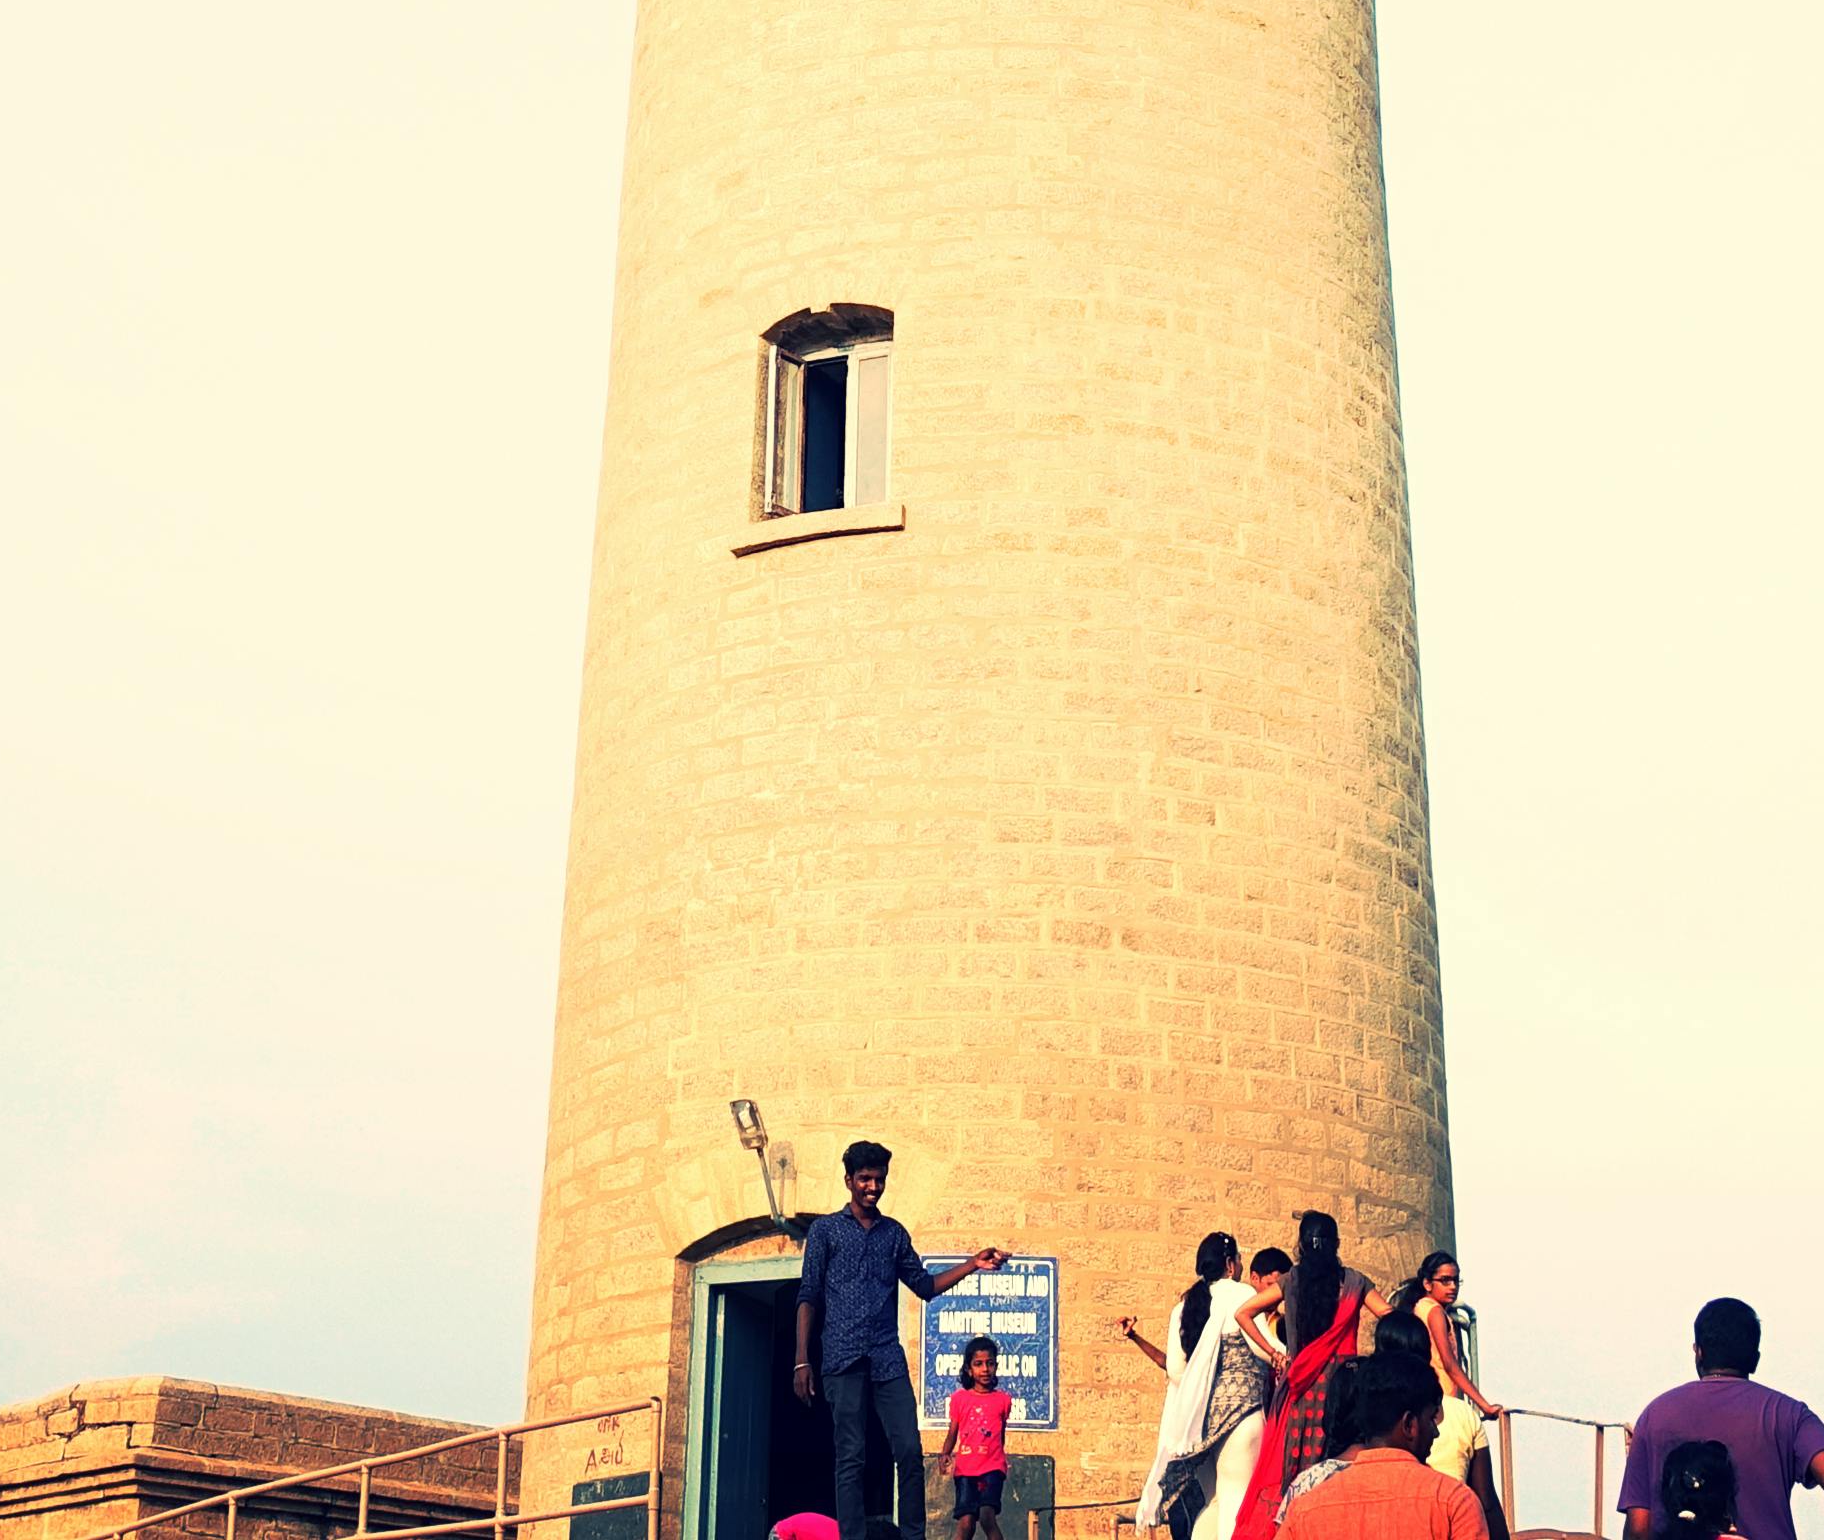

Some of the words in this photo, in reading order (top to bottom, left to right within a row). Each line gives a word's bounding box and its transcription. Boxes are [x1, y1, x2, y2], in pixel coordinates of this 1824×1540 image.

[980, 1274, 1025, 1296] MUSEUM
[1026, 1275, 1049, 1297] AND
[939, 1311, 990, 1333] MARITIME
[991, 1312, 1037, 1334] MUSEUM
[1021, 1355, 1037, 1377] ON
